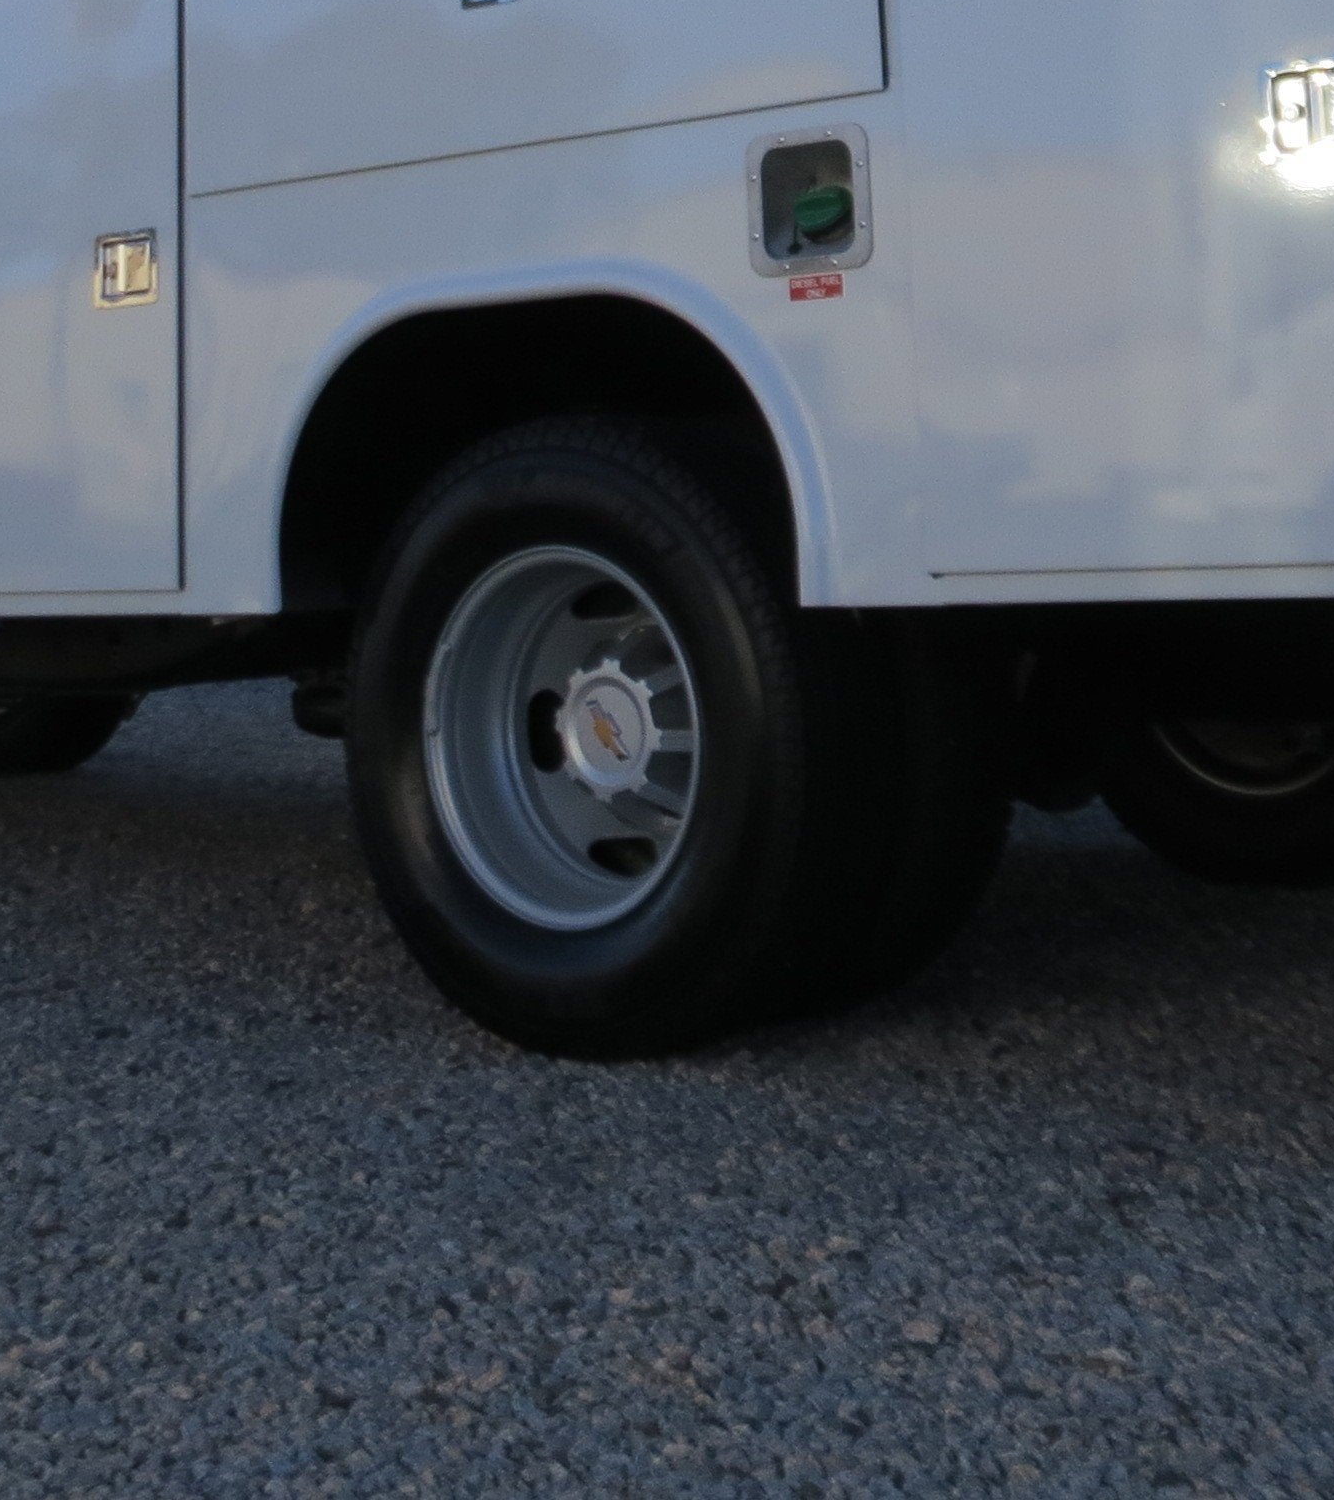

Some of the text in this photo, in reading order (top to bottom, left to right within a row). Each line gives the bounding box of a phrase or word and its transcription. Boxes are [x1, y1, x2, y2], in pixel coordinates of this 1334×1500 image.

[791, 274, 840, 289] DIESEL FUEL
[806, 288, 826, 299] ONLY
